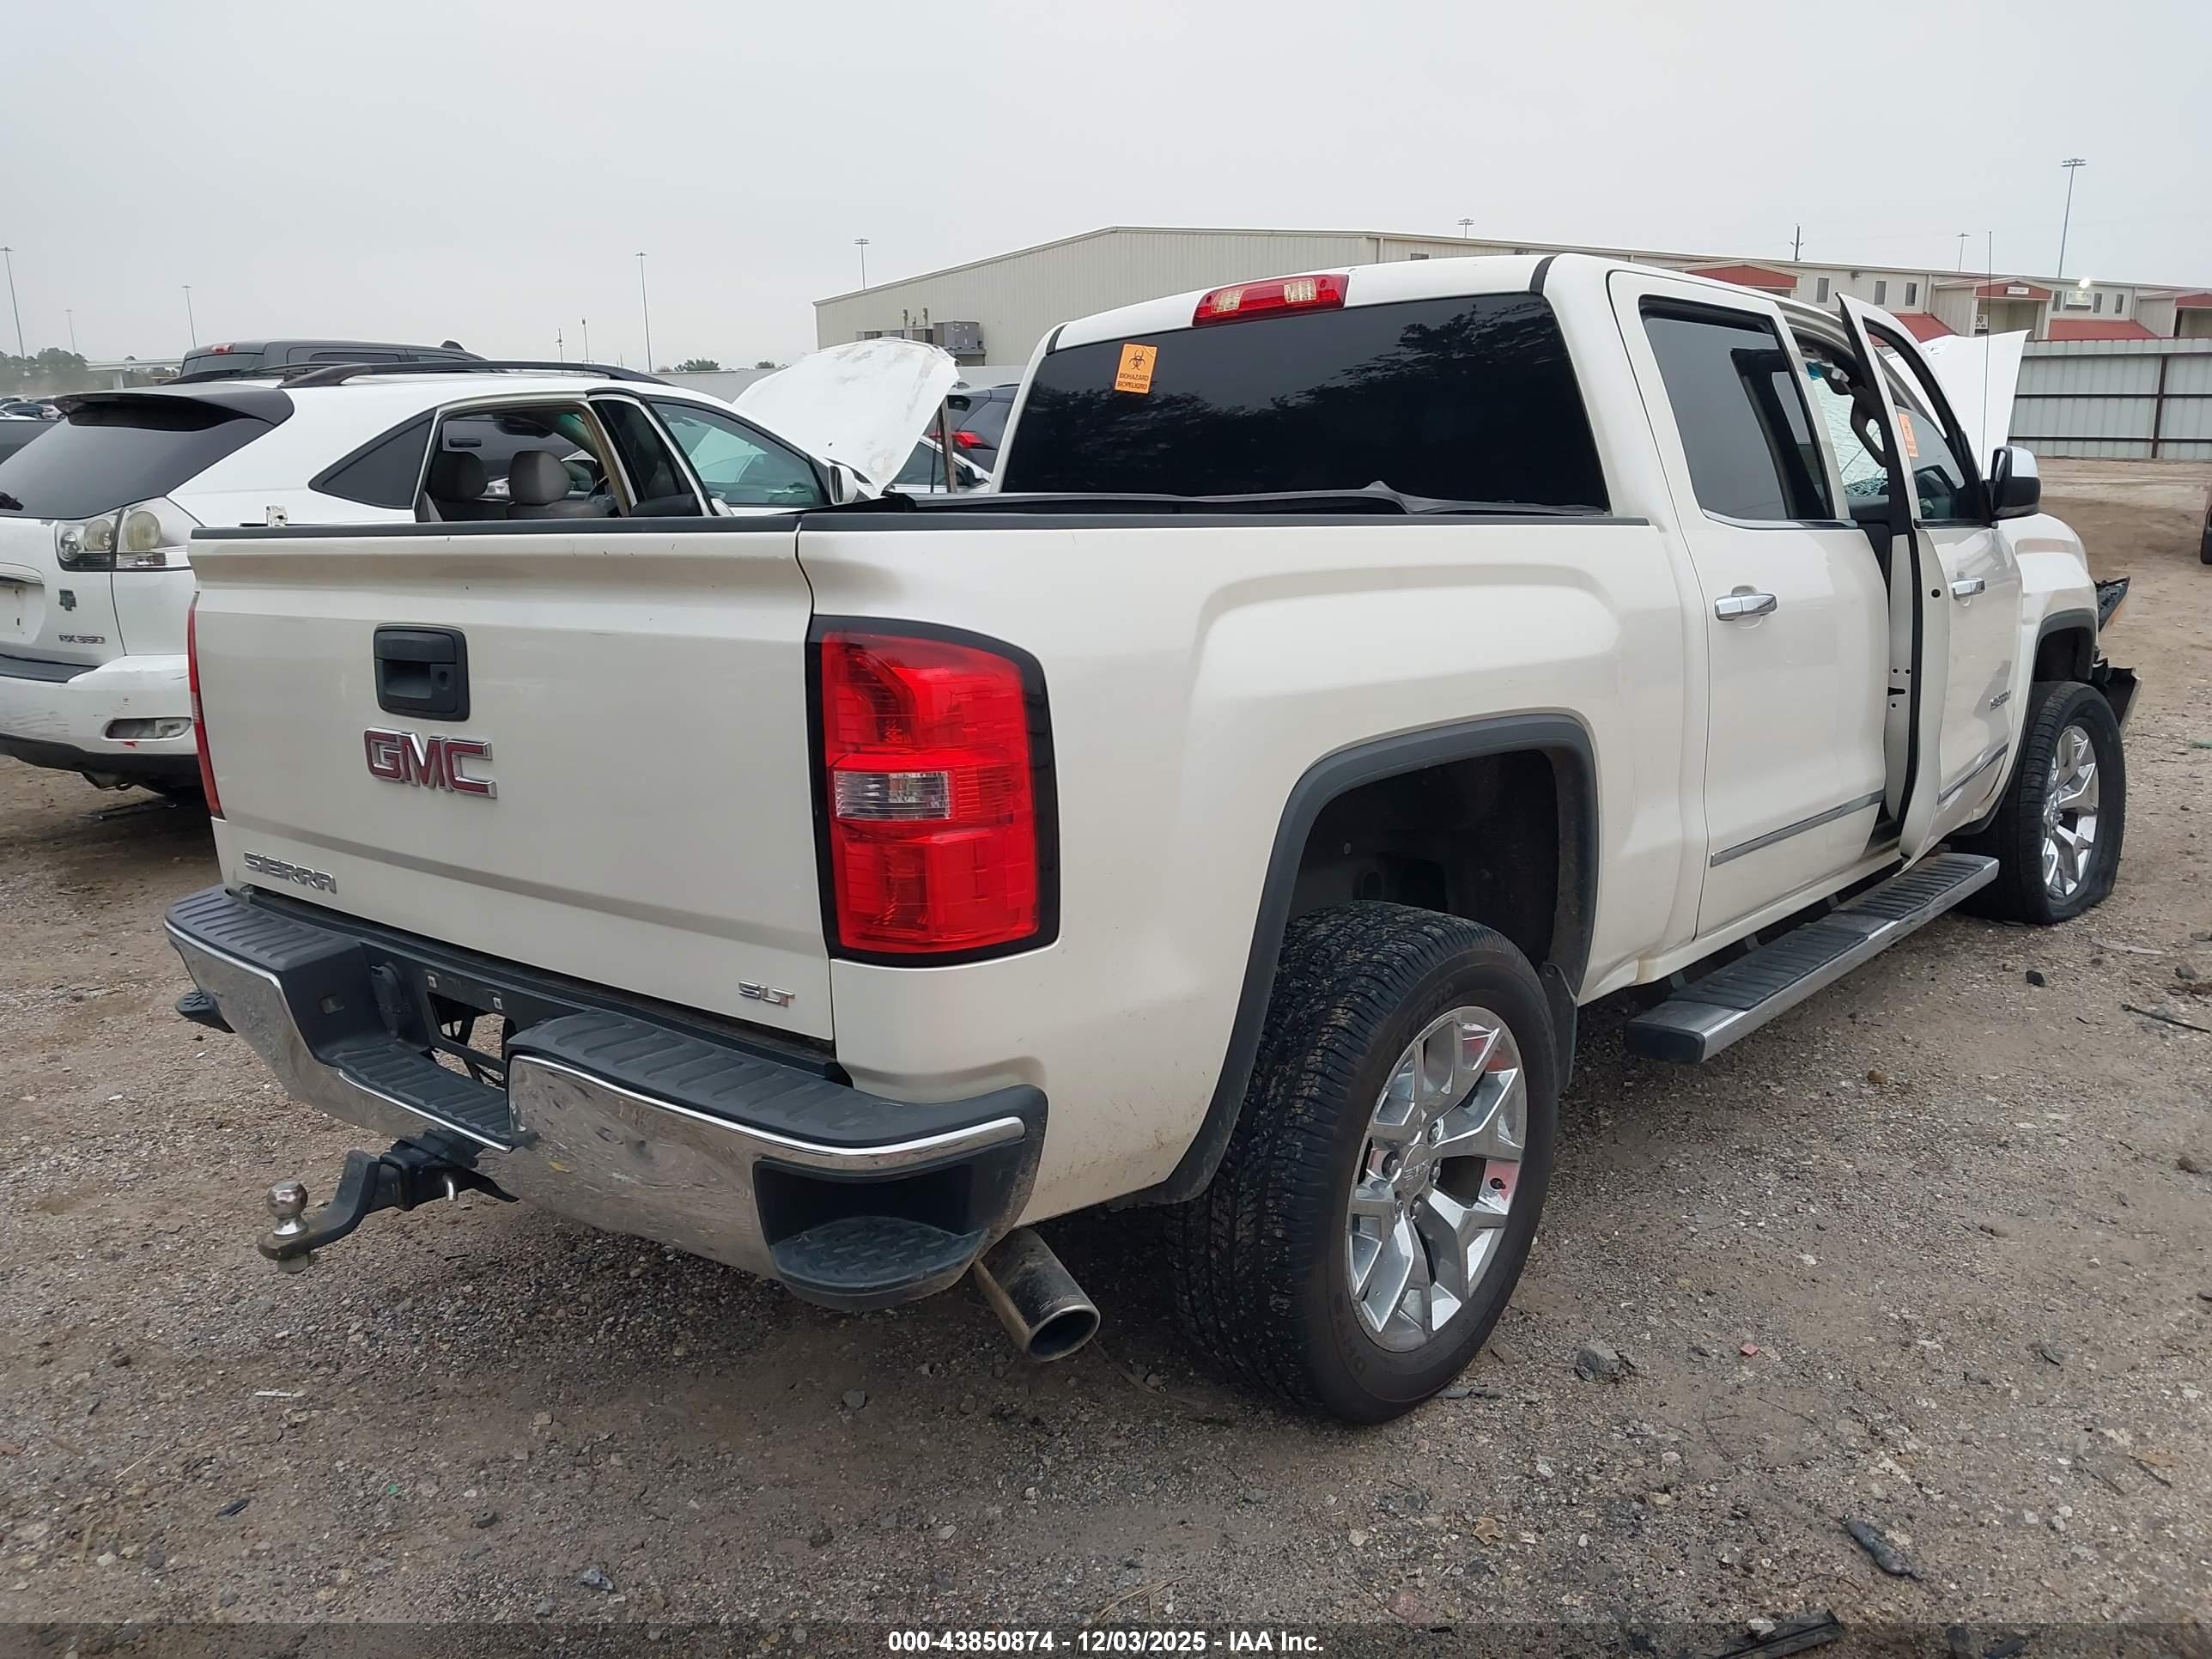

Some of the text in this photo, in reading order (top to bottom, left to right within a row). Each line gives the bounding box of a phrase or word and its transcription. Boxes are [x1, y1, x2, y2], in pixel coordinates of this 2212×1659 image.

[1119, 372, 1149, 381] BIOHAZARD
[363, 726, 498, 799] GMC
[244, 851, 337, 894] SIERRA
[738, 980, 796, 1008] SLT
